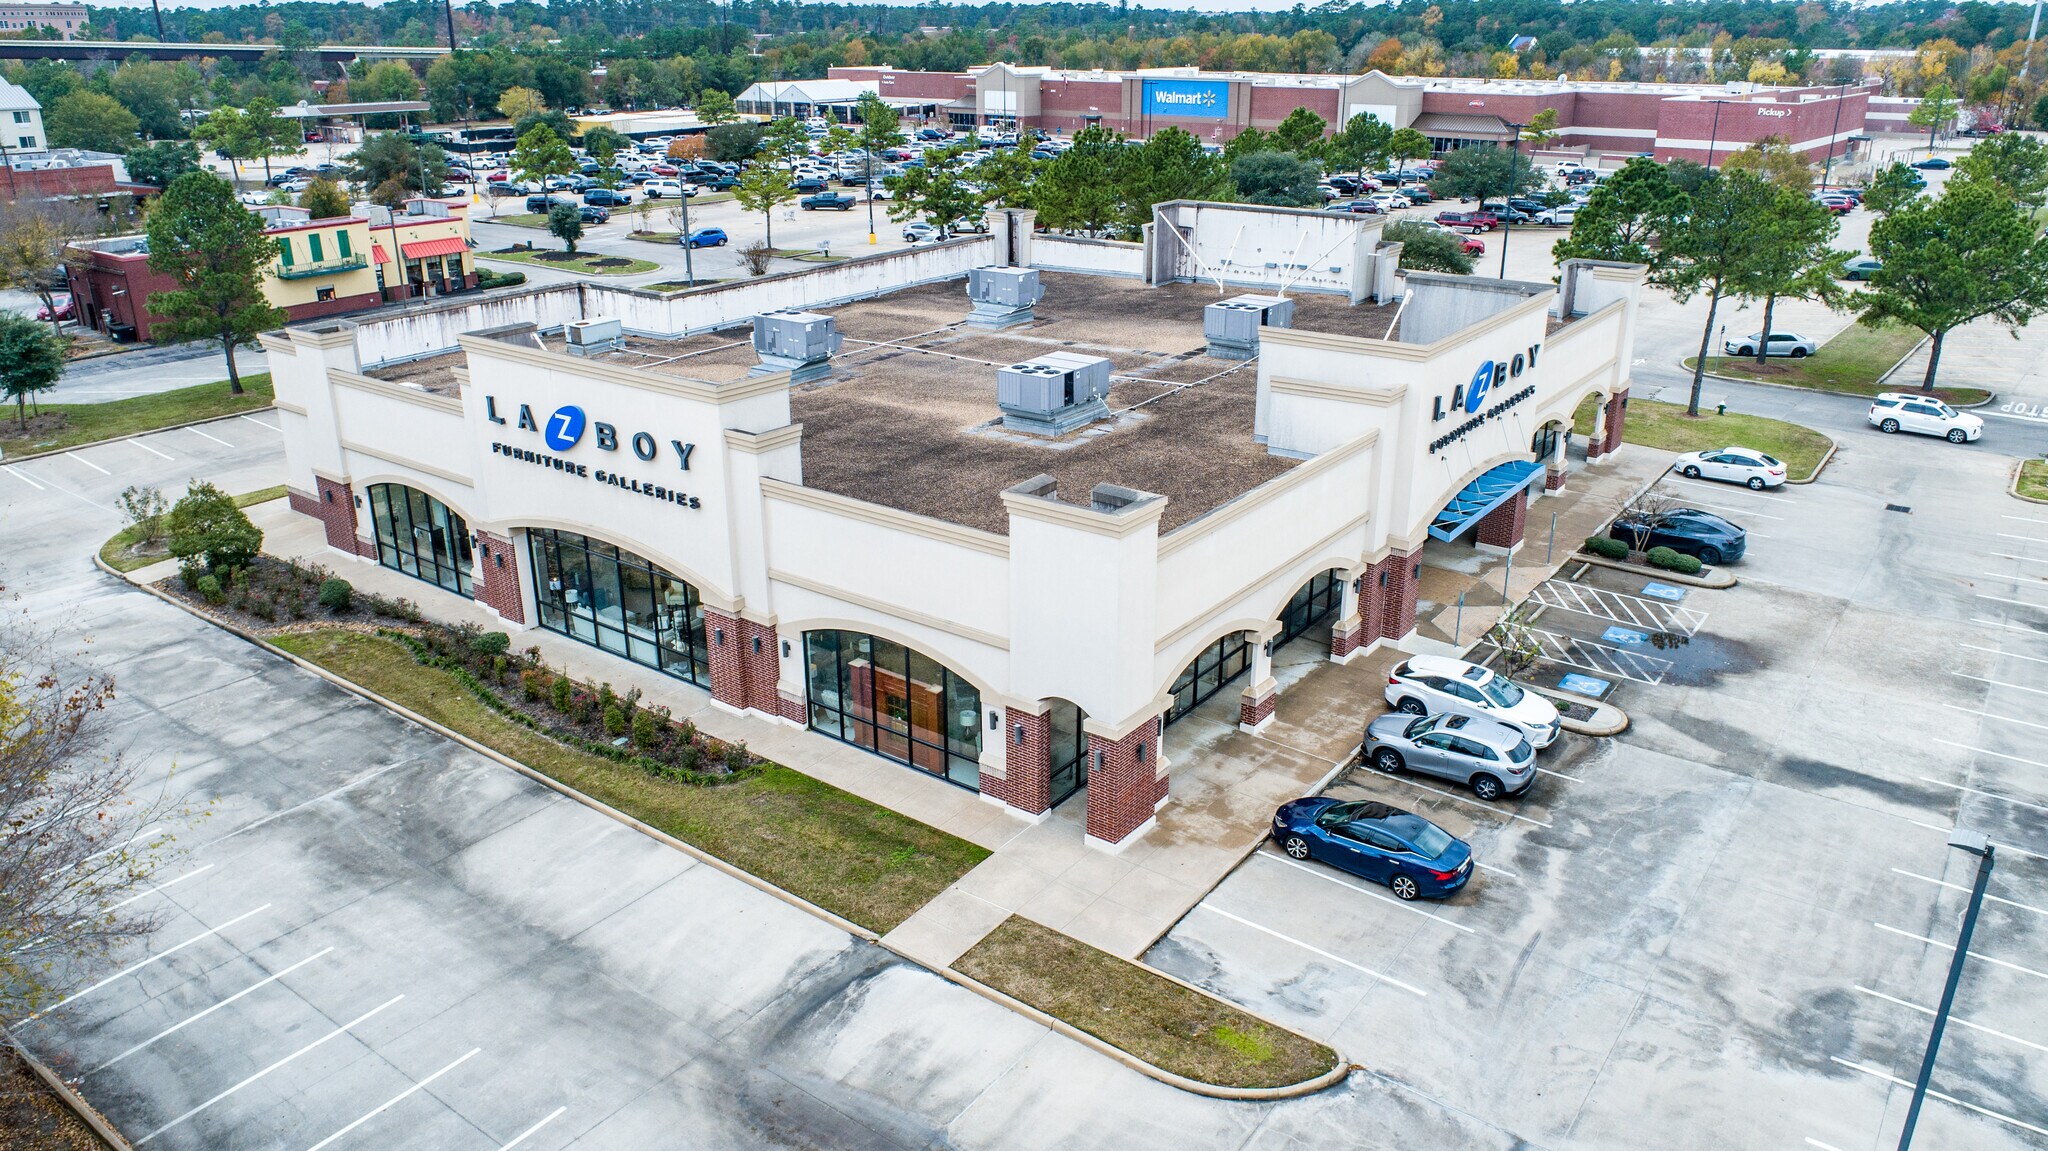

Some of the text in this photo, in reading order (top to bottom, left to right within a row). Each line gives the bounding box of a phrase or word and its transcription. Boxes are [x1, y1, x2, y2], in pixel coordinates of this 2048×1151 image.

[1155, 91, 1202, 105] Walmart
[1757, 107, 1785, 119] Pickup
[492, 442, 701, 510] FURNITURE GALLERIES
